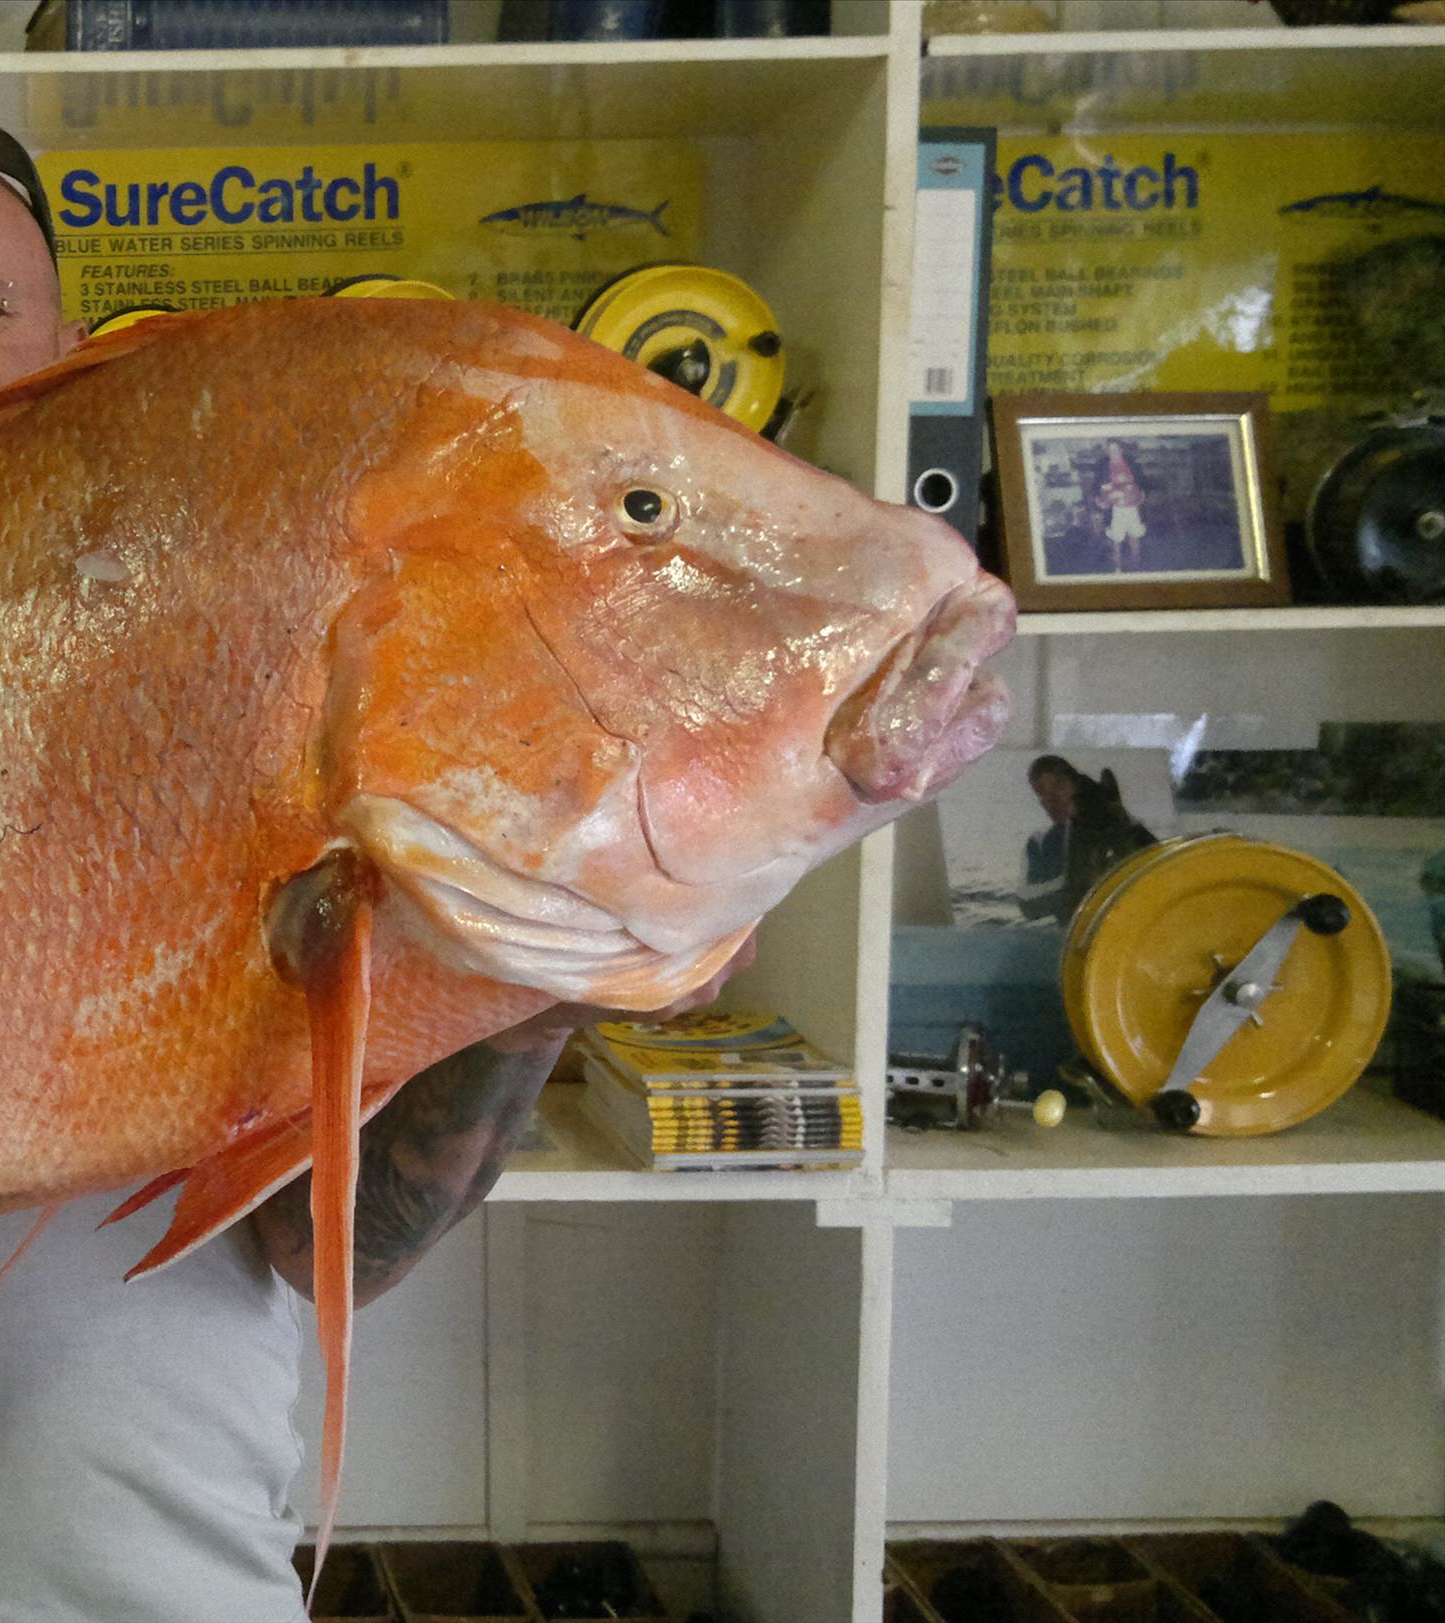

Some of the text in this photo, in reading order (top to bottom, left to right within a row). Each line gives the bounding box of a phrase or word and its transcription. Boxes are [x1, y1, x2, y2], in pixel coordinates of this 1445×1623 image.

[58, 163, 400, 227] SureCatch
[56, 231, 403, 253] BLUE WATER SERIES SPINNING REELS
[81, 283, 90, 296] 3
[94, 281, 186, 296] STAINLESS
[191, 280, 243, 294] STEEL
[249, 278, 292, 292] BALL
